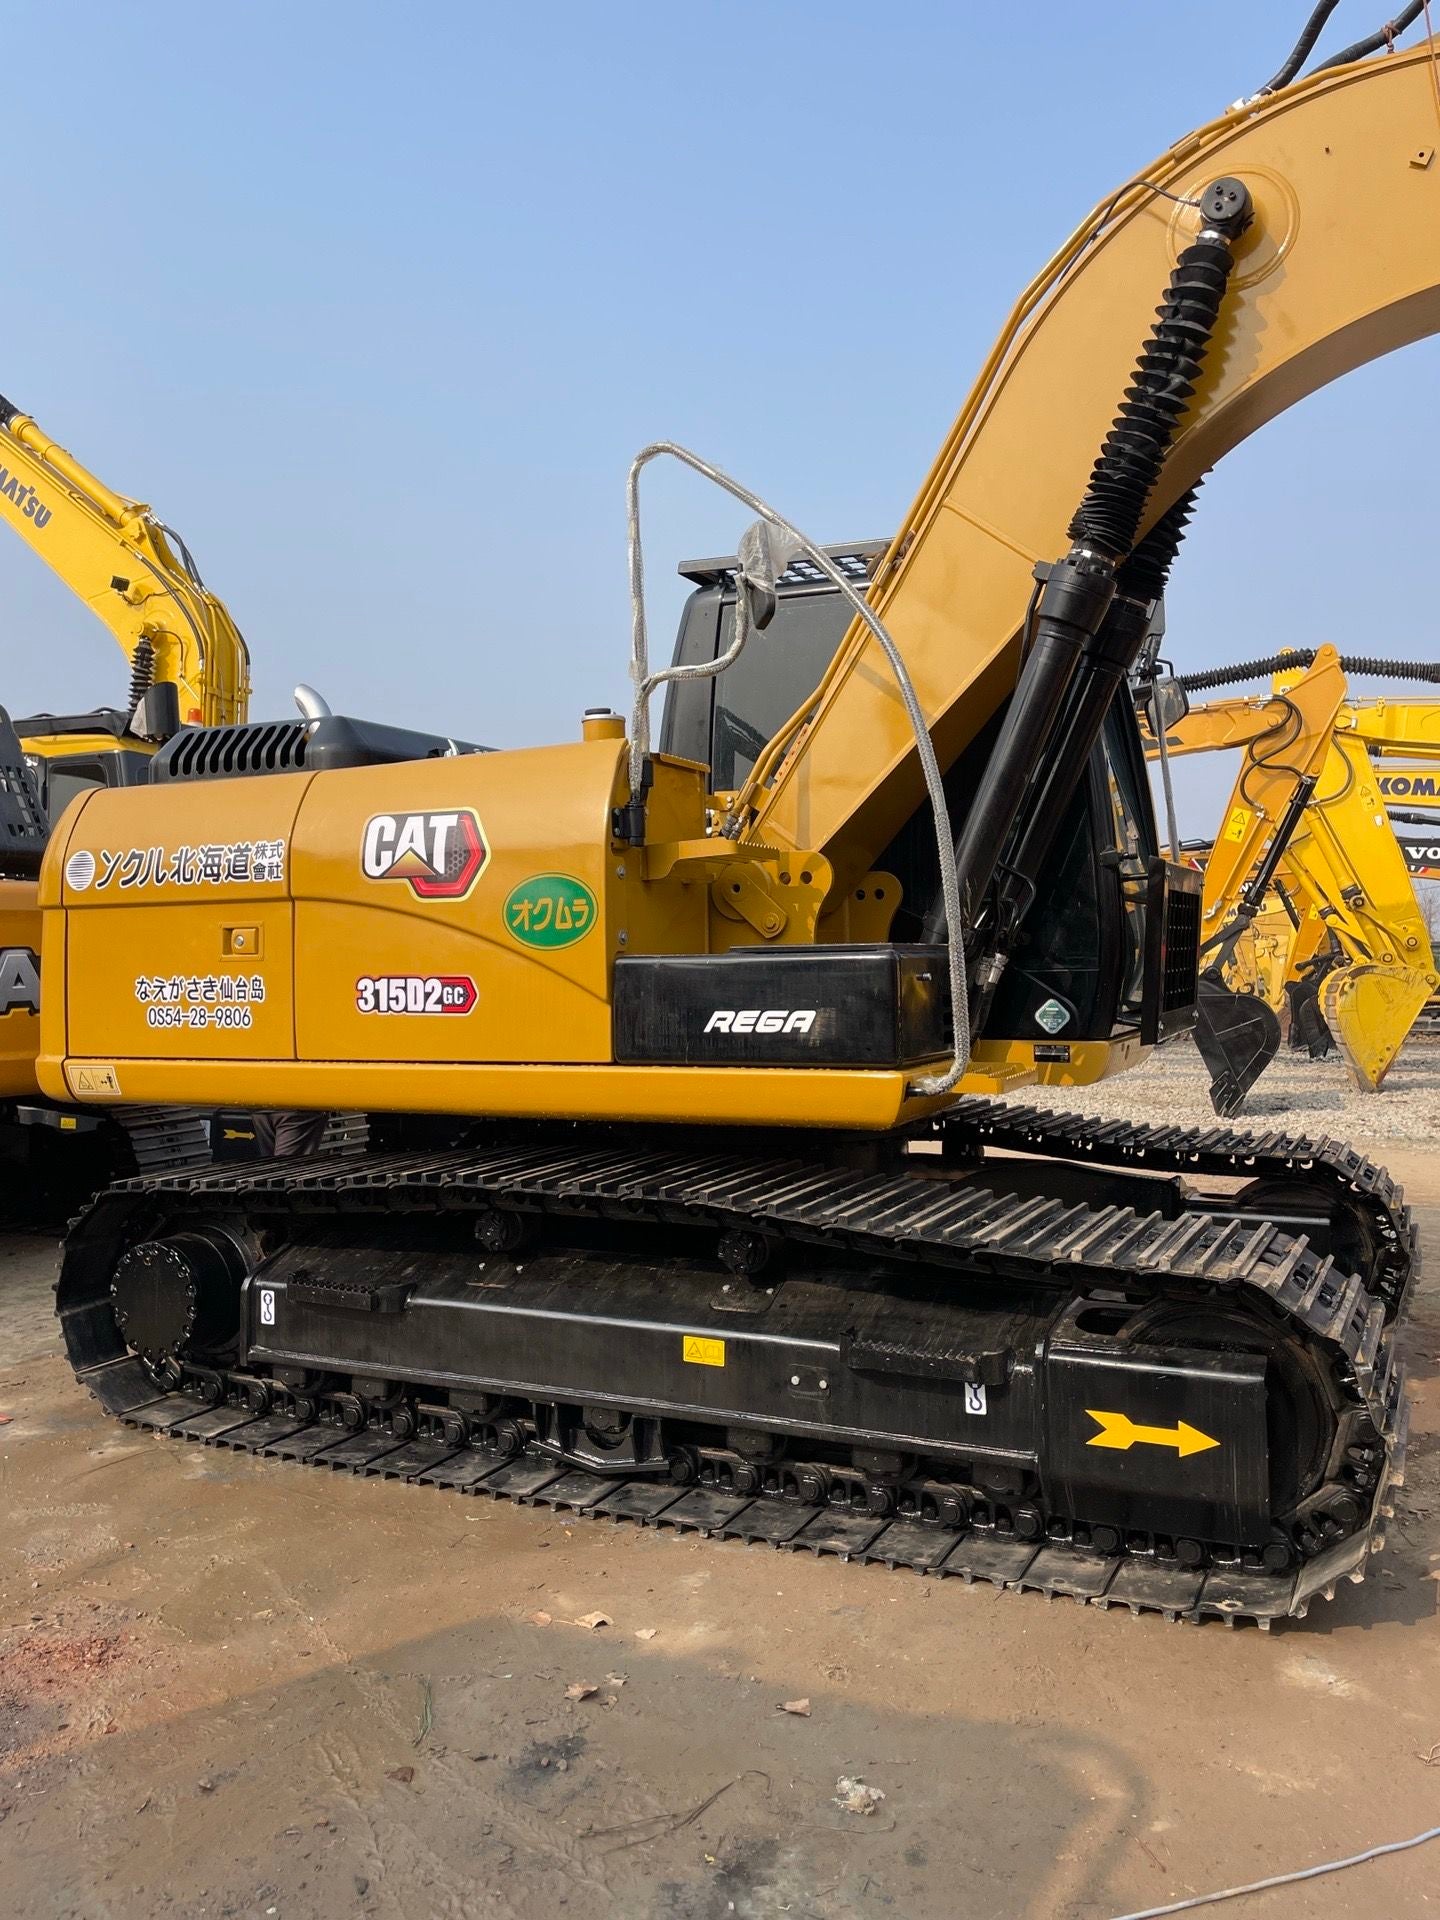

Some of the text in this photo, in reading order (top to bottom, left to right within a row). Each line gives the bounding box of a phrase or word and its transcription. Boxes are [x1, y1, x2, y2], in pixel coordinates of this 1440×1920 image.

[364, 814, 458, 877] CAT
[512, 897, 589, 931] オクムラ
[357, 978, 442, 1012] 315D2
[703, 1010, 817, 1033] REGA
